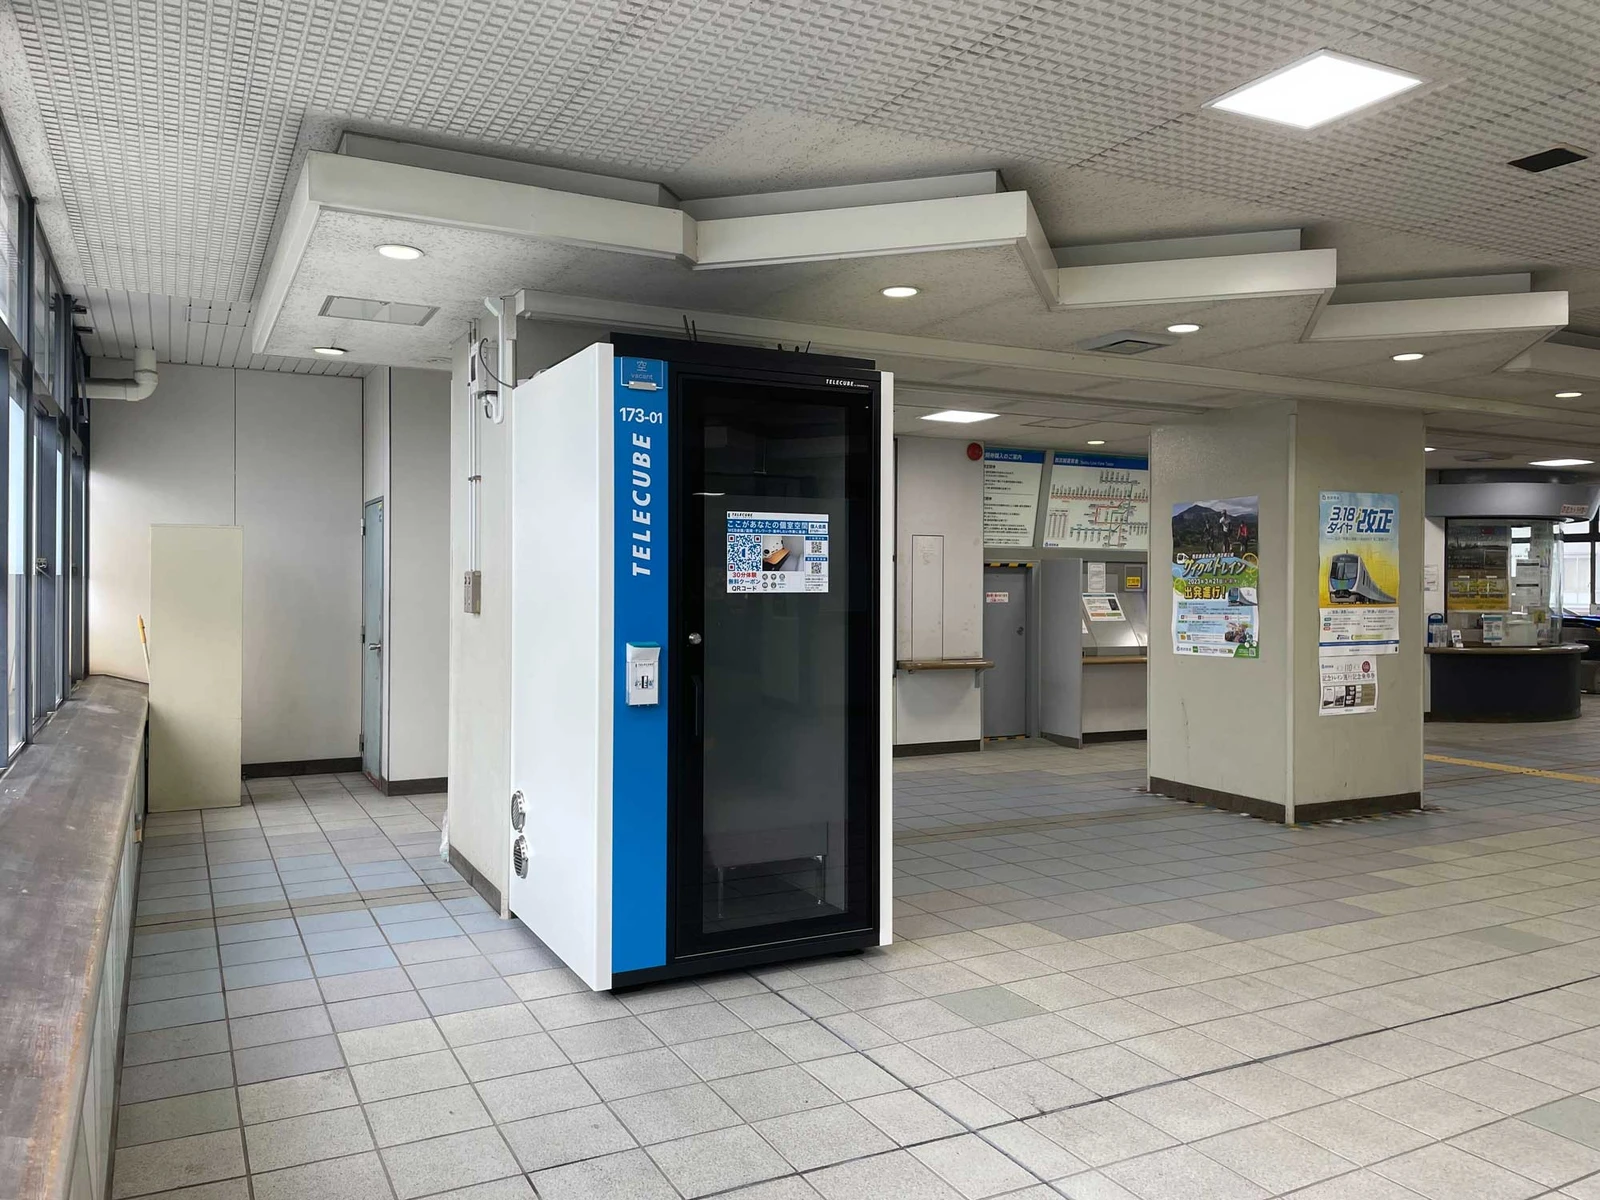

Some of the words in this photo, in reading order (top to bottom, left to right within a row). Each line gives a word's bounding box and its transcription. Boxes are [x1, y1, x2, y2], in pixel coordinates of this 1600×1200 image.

[636, 361, 647, 372] 空
[825, 378, 854, 387] TELECUBE
[619, 407, 663, 424] 173-01
[632, 432, 651, 577] TELECUBE
[1326, 522, 1353, 534] ダイヤ
[1356, 508, 1394, 533] 改正
[1329, 506, 1356, 521] 3.18
[1182, 557, 1246, 577] サイクルトレイン
